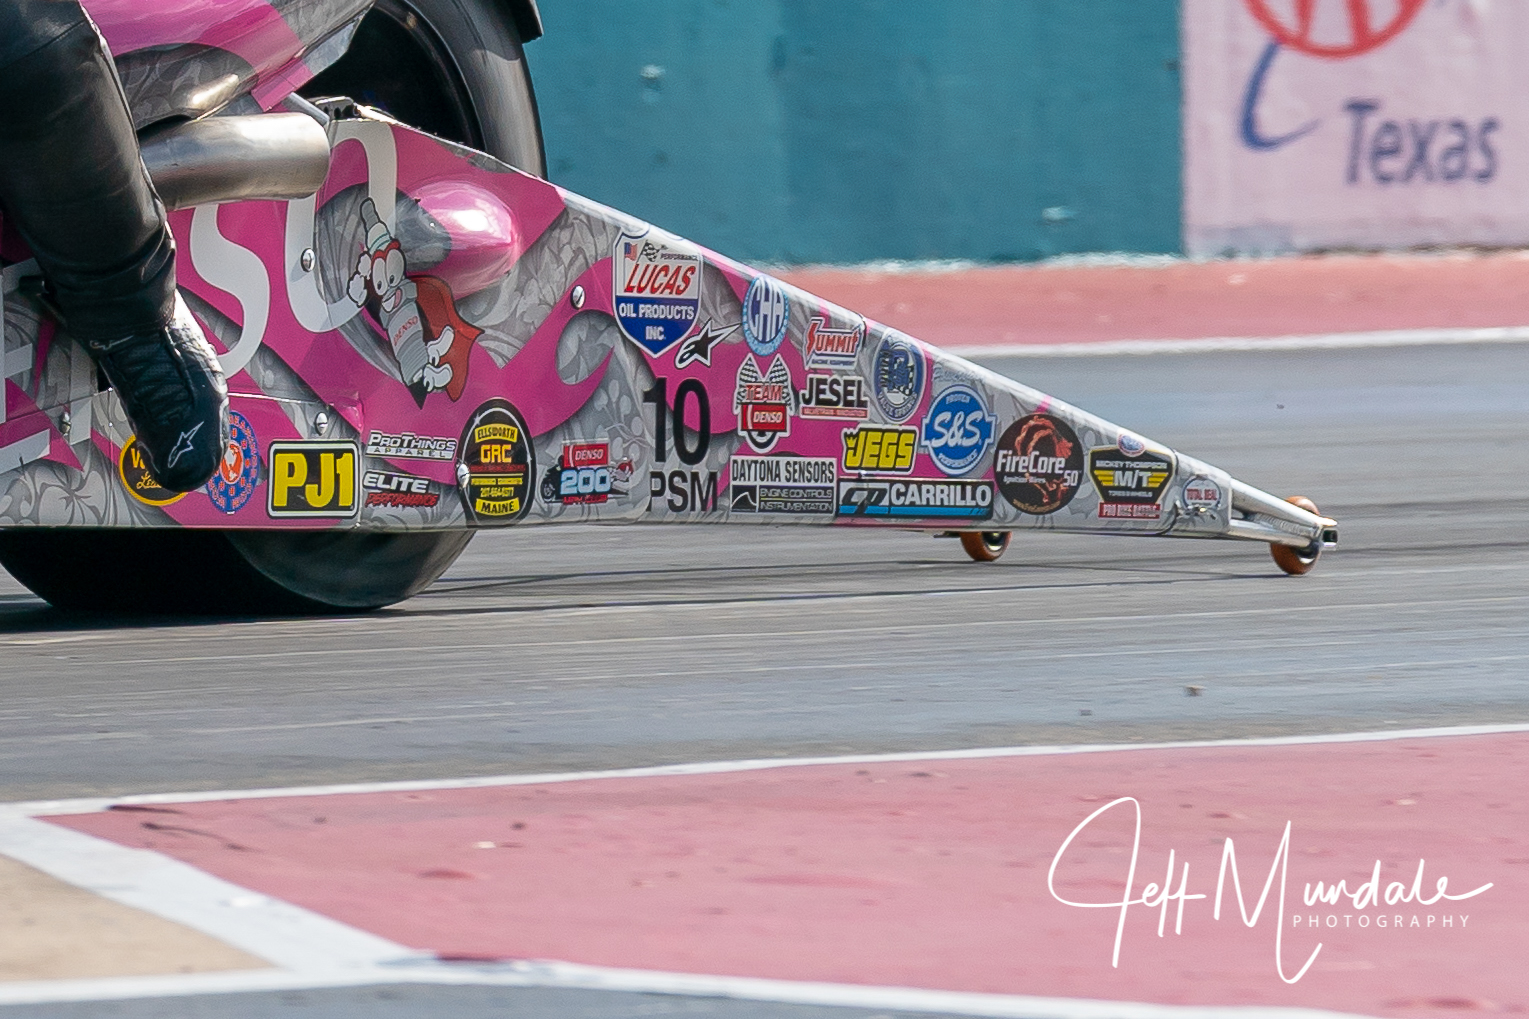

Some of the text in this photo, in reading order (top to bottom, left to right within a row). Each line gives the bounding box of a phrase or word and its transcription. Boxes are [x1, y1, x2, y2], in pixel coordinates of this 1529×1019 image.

[1343, 98, 1501, 187] Texas
[623, 263, 697, 296] LUCAS
[618, 303, 695, 320] OIL PRODUCTS
[393, 315, 419, 347] DENSO
[645, 325, 667, 341] INC.
[745, 383, 783, 401] TEAM
[801, 377, 869, 408] JESEL
[642, 377, 711, 466] 10
[753, 411, 783, 424] DENSO
[477, 426, 515, 440] ELLSWORTH
[932, 411, 984, 448] S&S
[373, 447, 446, 457] APPAREL
[480, 444, 512, 463] GRC
[574, 448, 604, 461] DENSO
[847, 431, 916, 469] JEGS
[996, 449, 1066, 474] FireCore
[273, 452, 354, 508] PJ1
[732, 459, 835, 484] DAYTONA SENSORS
[1063, 469, 1079, 487] 50
[1114, 470, 1151, 488] M/T
[363, 473, 429, 493] ELITE
[560, 469, 611, 495] 200
[649, 470, 718, 512] PSM
[365, 493, 439, 507] PERFORMANCE
[759, 487, 832, 499] ENGINE CONTROLS
[890, 482, 991, 507] CARRILLO
[481, 500, 515, 514] MAINE
[759, 500, 833, 511] INSTRUMENTATION
